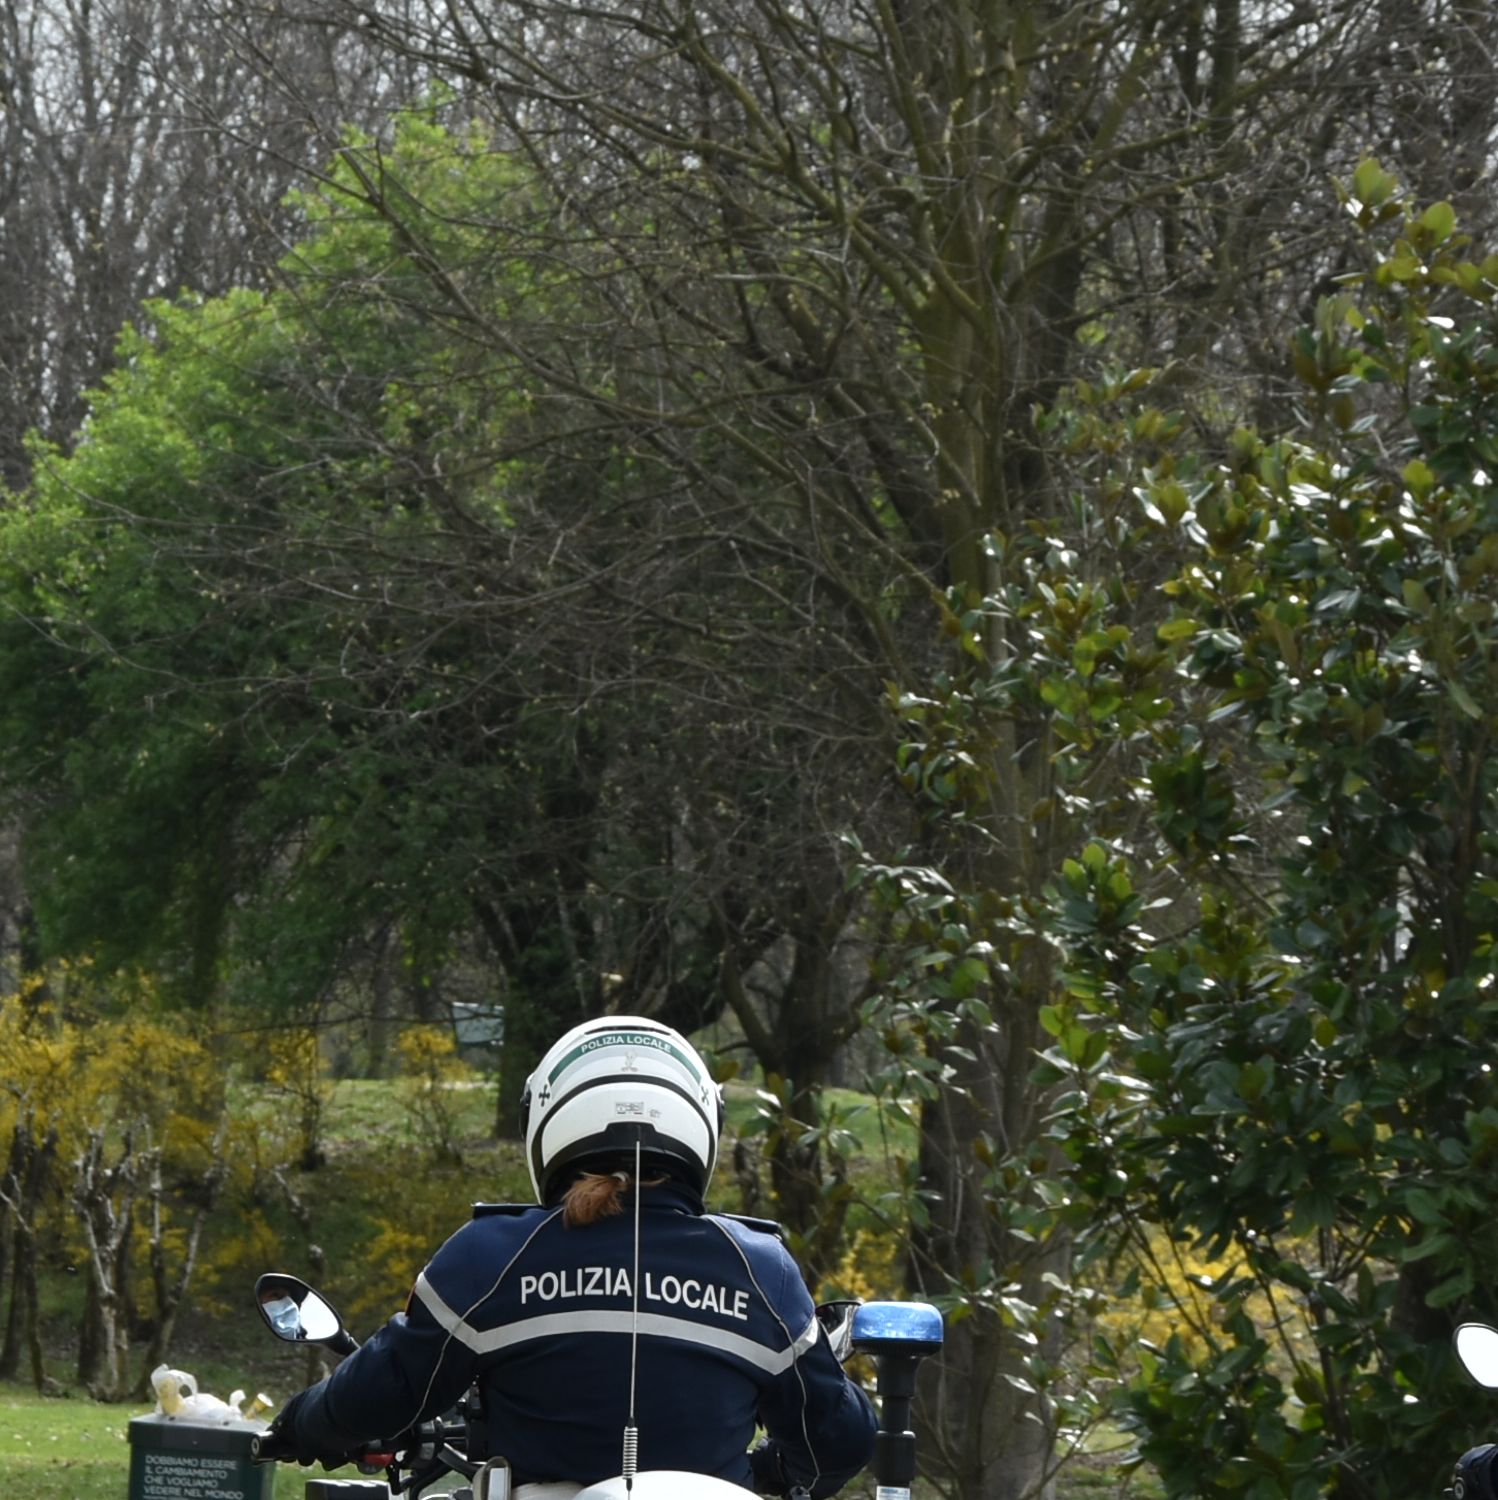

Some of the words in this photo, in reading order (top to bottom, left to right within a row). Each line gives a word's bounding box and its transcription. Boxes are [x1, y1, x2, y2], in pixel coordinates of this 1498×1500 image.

[581, 1035, 625, 1053] POLIZIA
[627, 1035, 671, 1053] LOCALE
[520, 1267, 633, 1305] POLIZIA
[645, 1272, 750, 1321] LOCALE
[145, 1455, 199, 1467] DOBBIAMO
[200, 1459, 237, 1470] ESSERE
[145, 1466, 153, 1474] IL
[155, 1466, 228, 1479] CAMBIAMENTO
[144, 1475, 164, 1485] CHE
[166, 1476, 219, 1489] VOGLIAMO
[143, 1485, 181, 1496] VEDERE
[183, 1488, 203, 1498] NEL
[205, 1489, 244, 1500] MONDO
